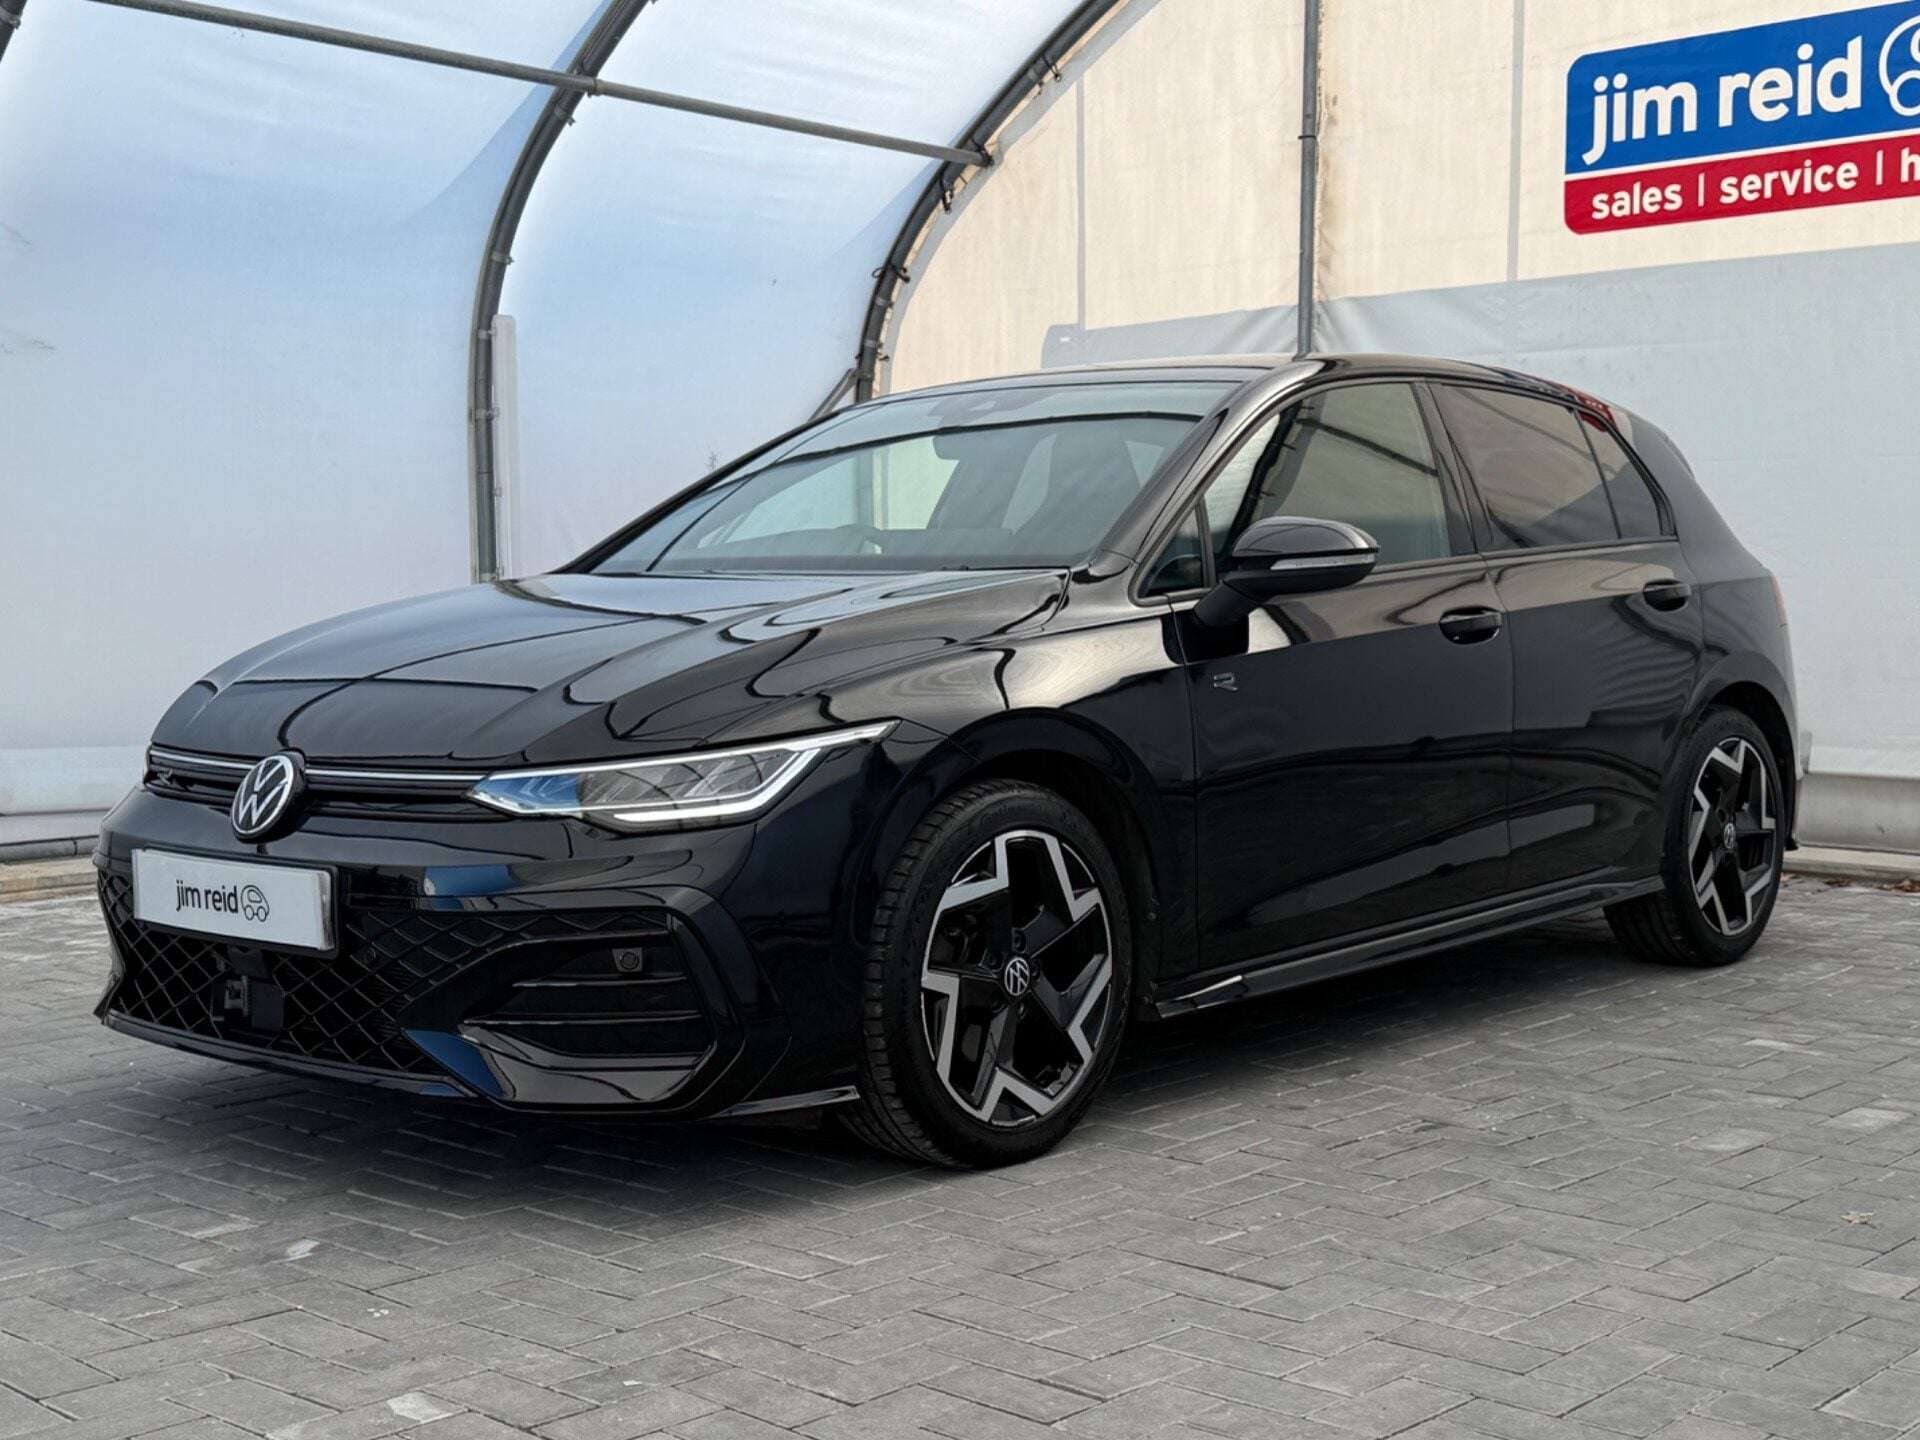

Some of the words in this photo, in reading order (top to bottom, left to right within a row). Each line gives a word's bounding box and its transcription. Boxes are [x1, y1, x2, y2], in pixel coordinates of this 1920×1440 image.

[1582, 73, 1697, 165] jim
[1718, 36, 1862, 127] reid
[1592, 182, 1683, 219] sales
[1719, 160, 1859, 204] service
[234, 756, 291, 831] VW
[176, 880, 200, 912] jim
[205, 885, 239, 913] reid
